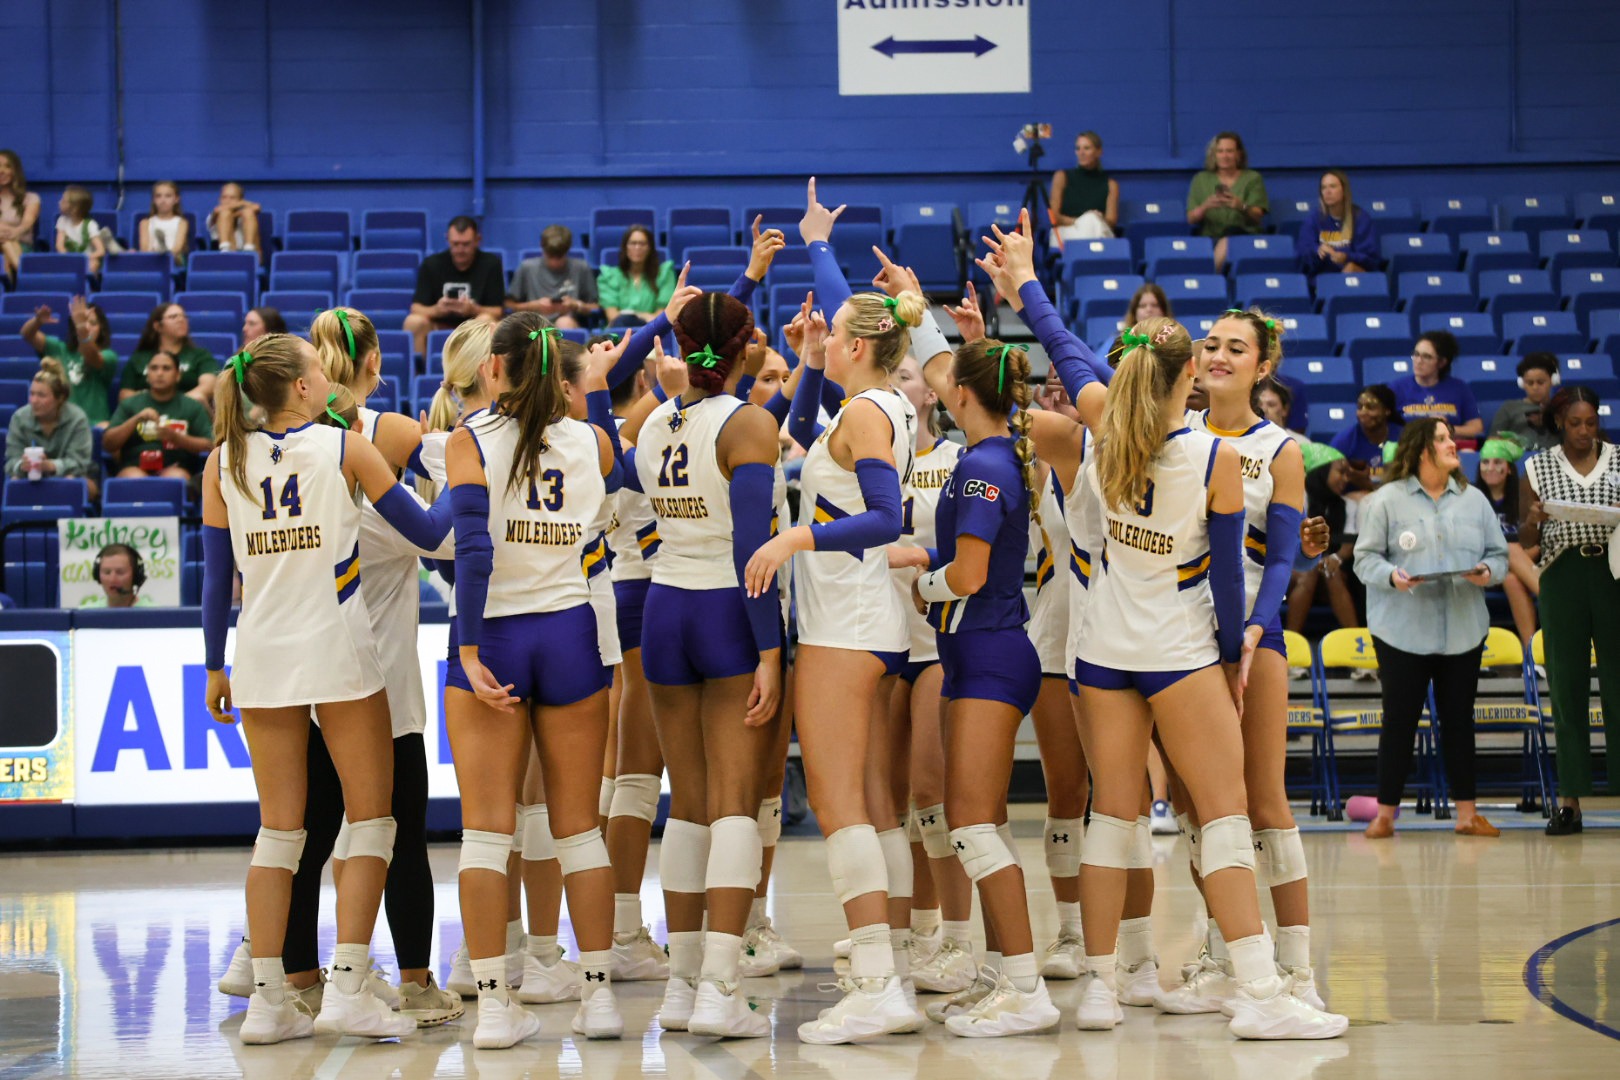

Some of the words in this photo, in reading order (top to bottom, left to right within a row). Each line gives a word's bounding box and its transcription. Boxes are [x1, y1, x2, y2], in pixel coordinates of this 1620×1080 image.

[658, 443, 689, 488] 12
[260, 473, 302, 520] 14
[526, 468, 564, 512] 13
[964, 480, 999, 502] GAC
[246, 525, 321, 556] MULERIDERS
